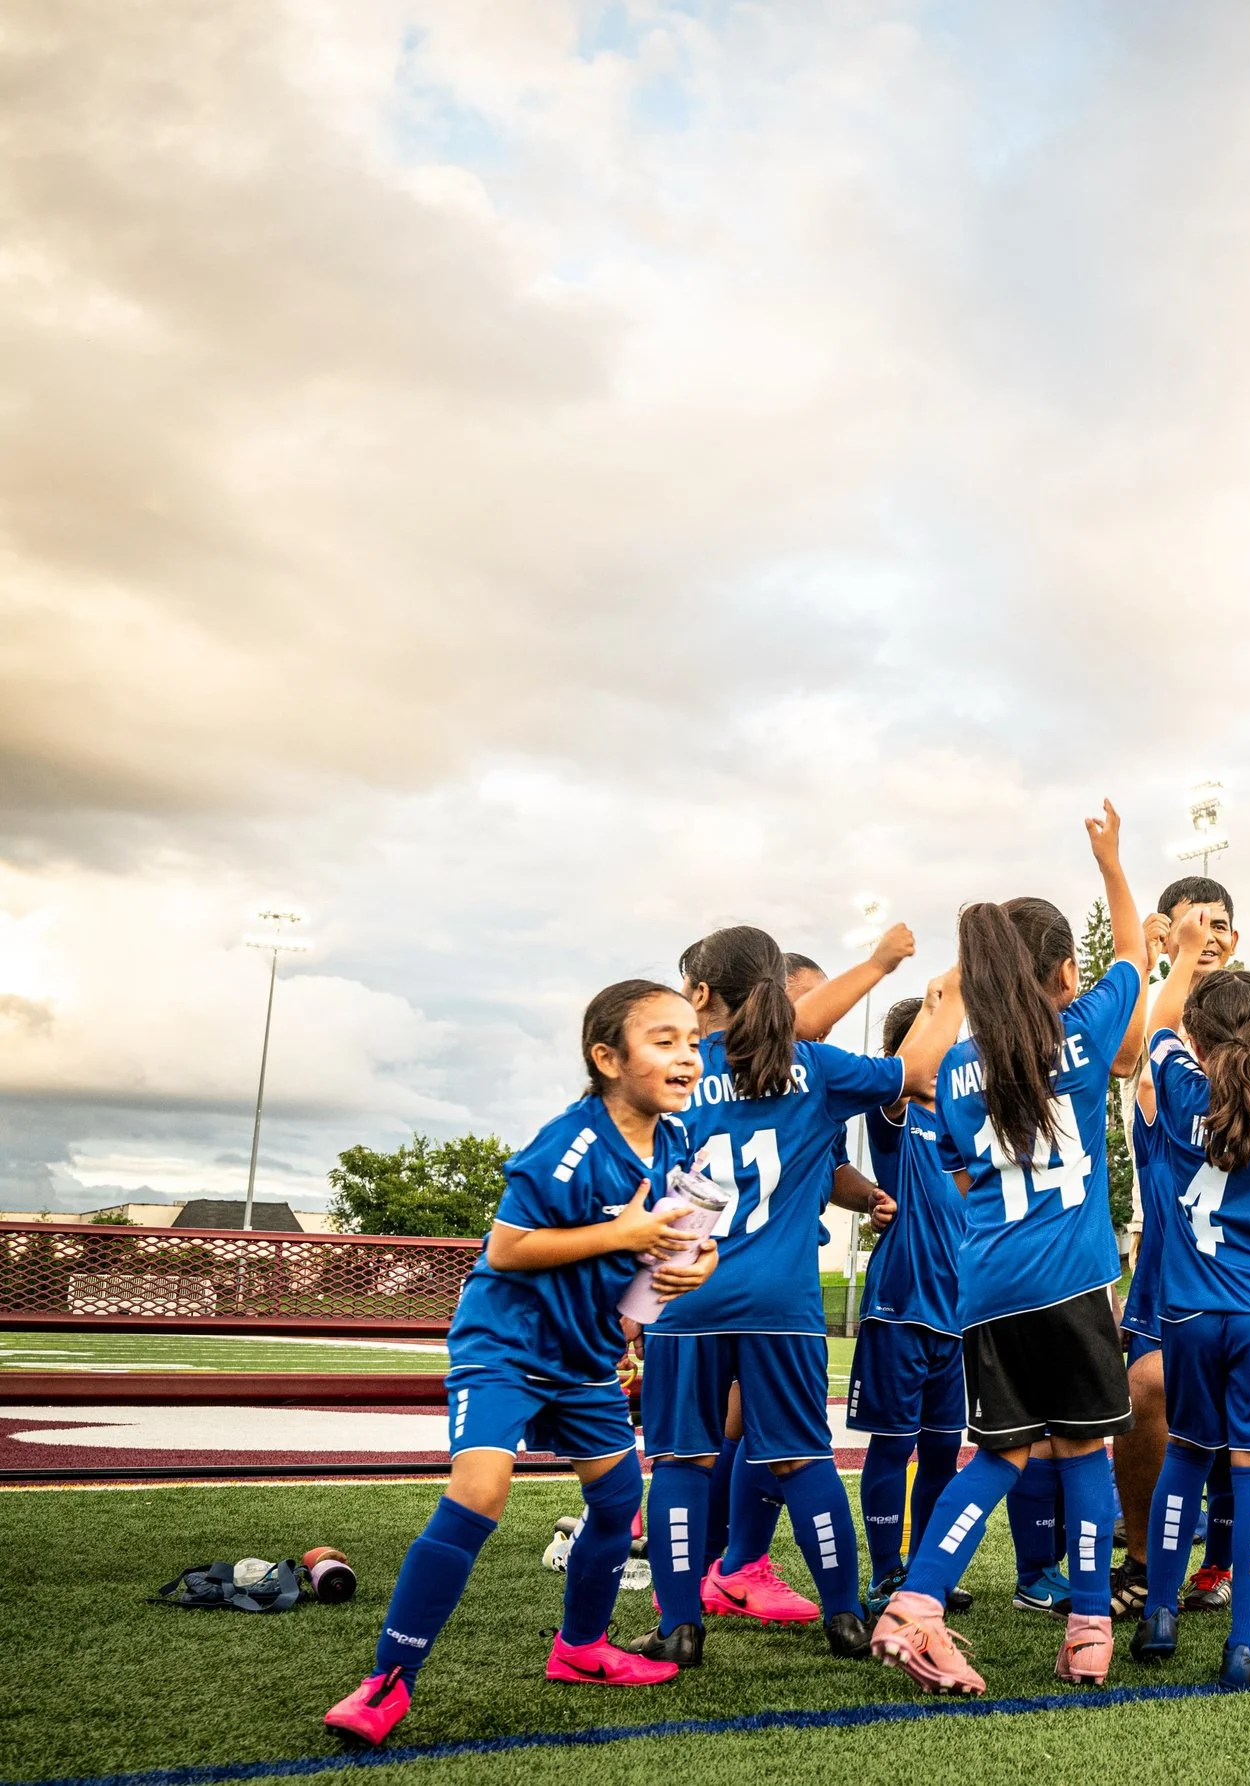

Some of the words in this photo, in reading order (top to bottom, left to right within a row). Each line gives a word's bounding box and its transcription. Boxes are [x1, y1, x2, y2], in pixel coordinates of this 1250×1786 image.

[694, 1128, 781, 1237] 11
[974, 1094, 1092, 1223] 14
[1178, 1161, 1229, 1257] 4
[386, 1627, 429, 1647] capelli
